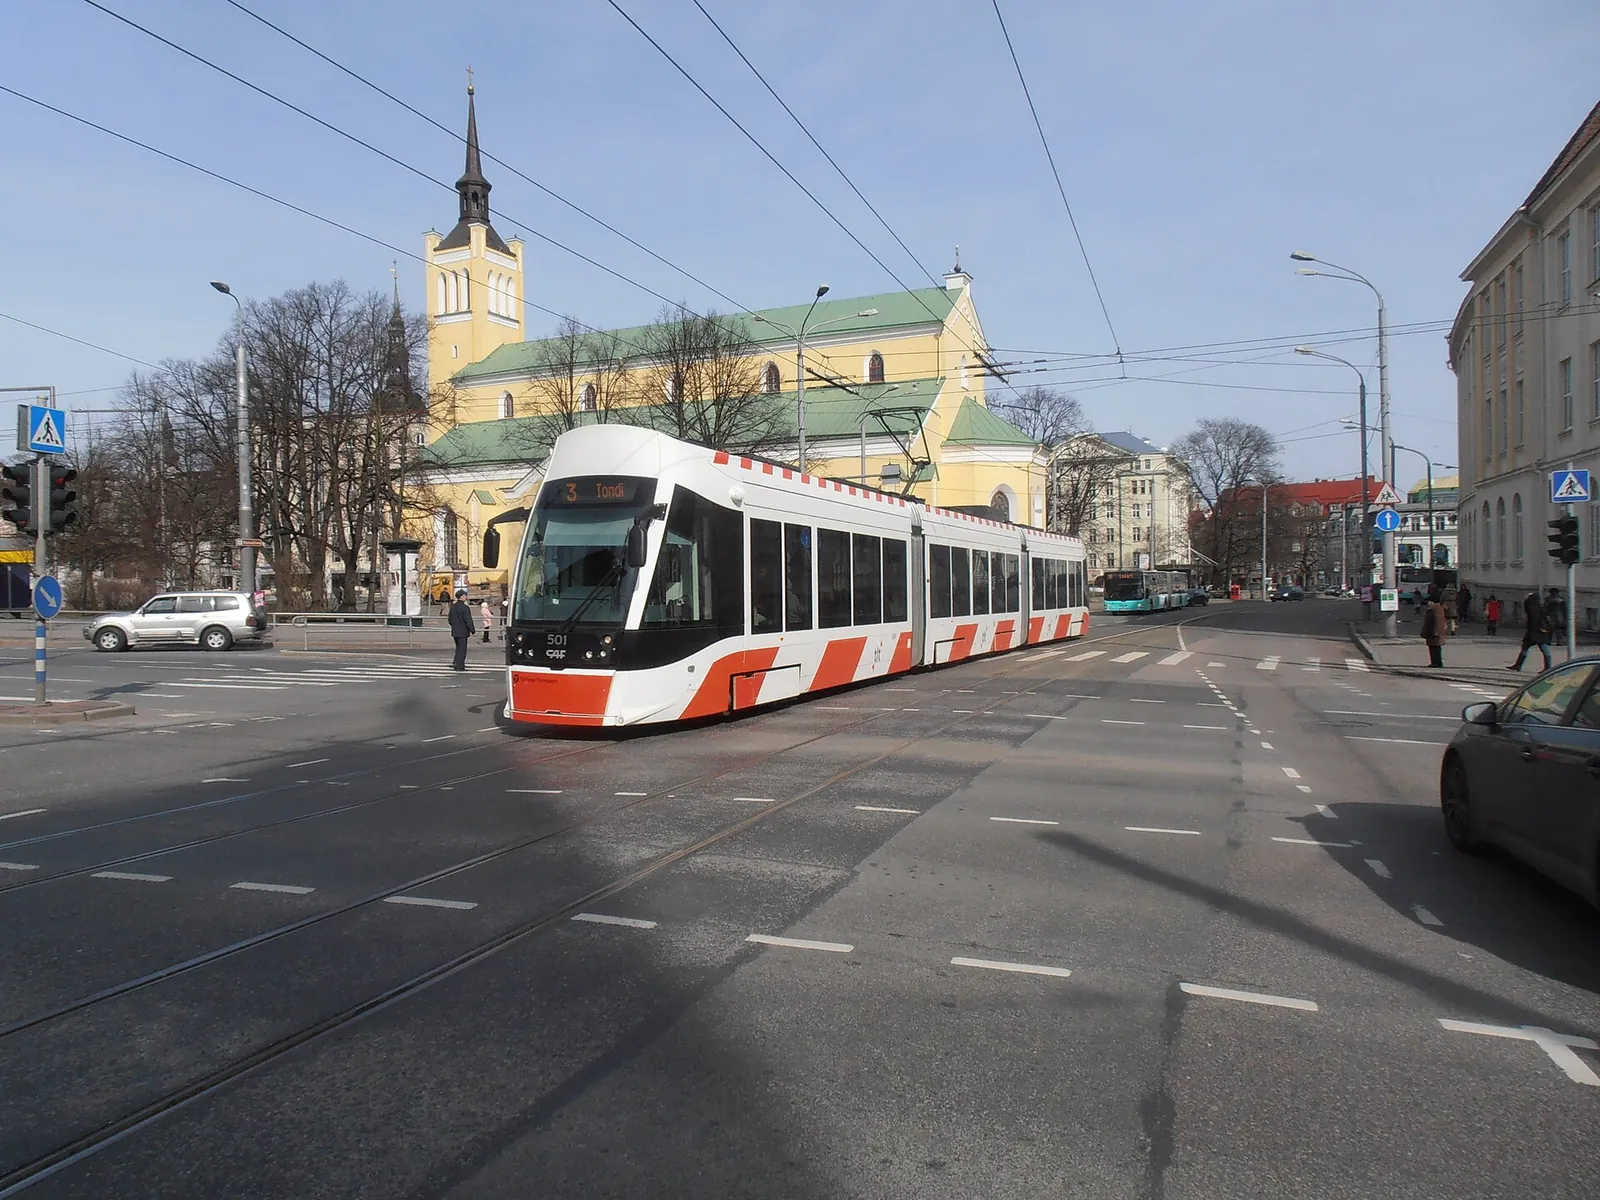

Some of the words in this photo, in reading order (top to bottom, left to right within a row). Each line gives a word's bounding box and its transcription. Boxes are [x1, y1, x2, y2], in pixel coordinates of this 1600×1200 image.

[567, 483, 577, 502] 3
[596, 483, 624, 498] Tondi
[547, 634, 567, 646] 501
[546, 650, 566, 659] CAF
